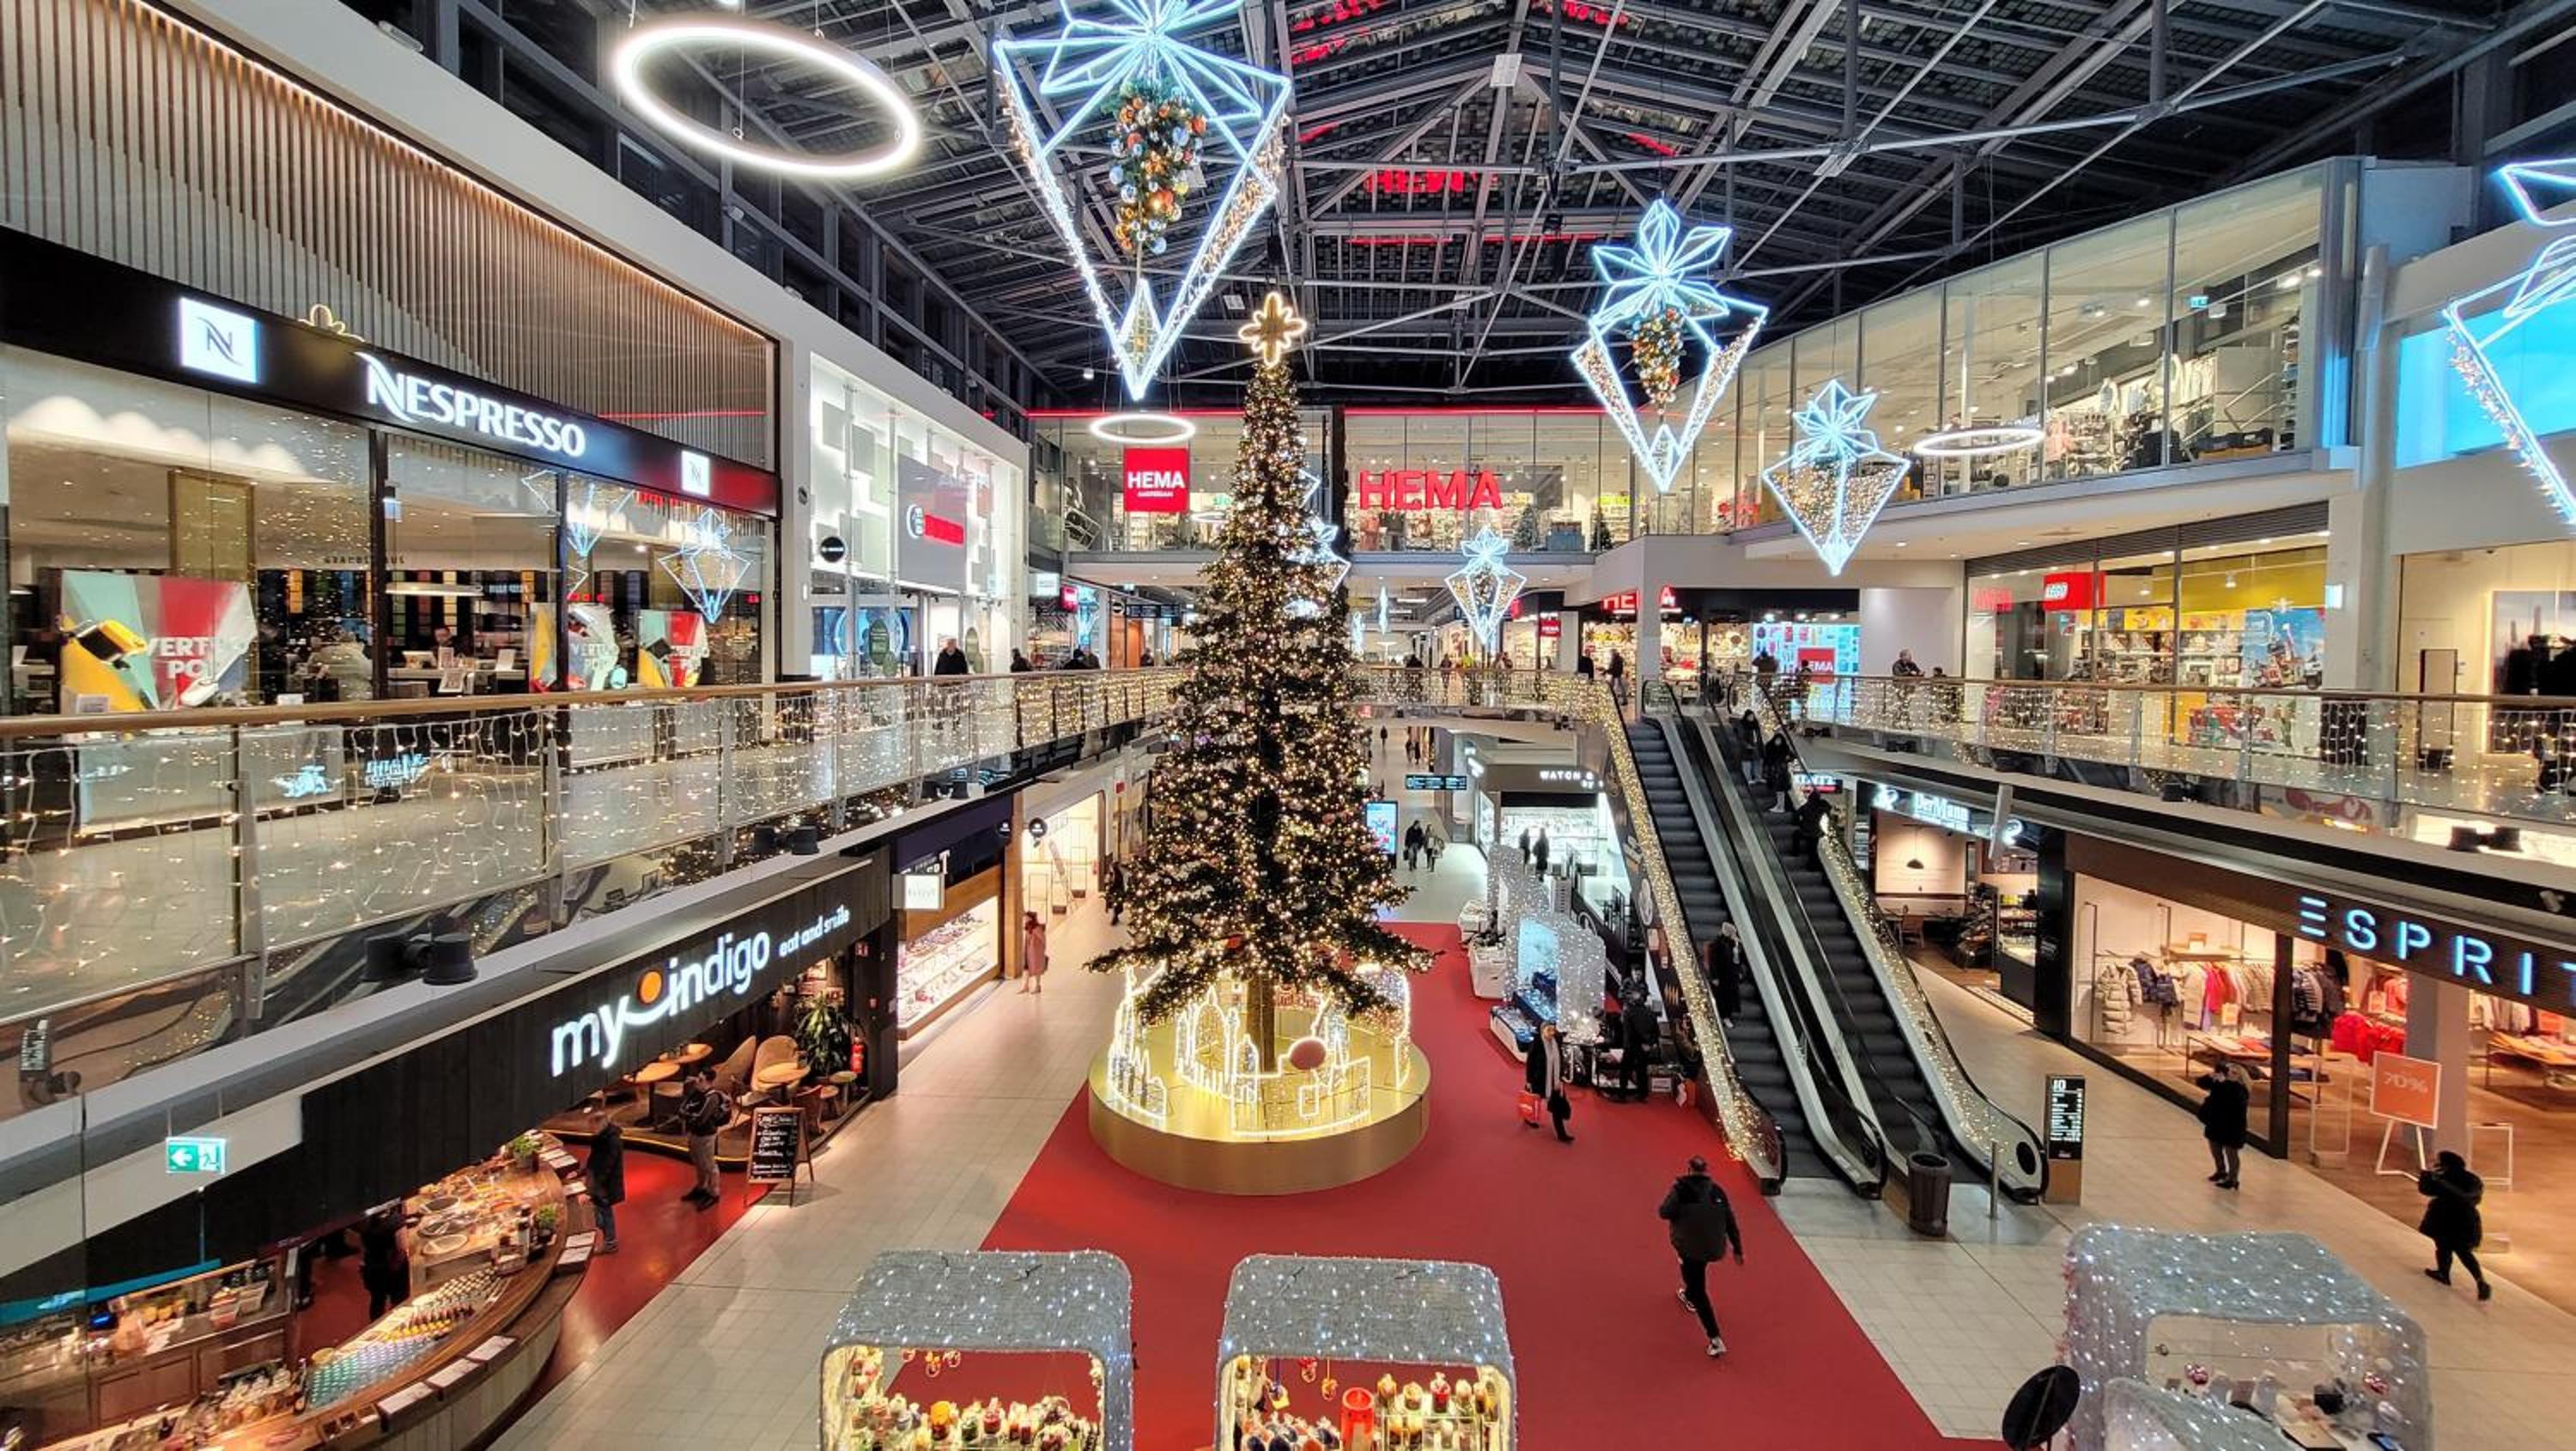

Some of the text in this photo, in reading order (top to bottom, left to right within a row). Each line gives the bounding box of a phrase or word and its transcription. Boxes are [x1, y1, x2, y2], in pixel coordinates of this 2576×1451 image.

[354, 349, 586, 458] NESPRESSO
[1127, 470, 1185, 489] HEMA
[1359, 469, 1503, 511] HEMA
[1807, 659, 1833, 671] EMA
[551, 904, 850, 1078] my indigo eat and smile
